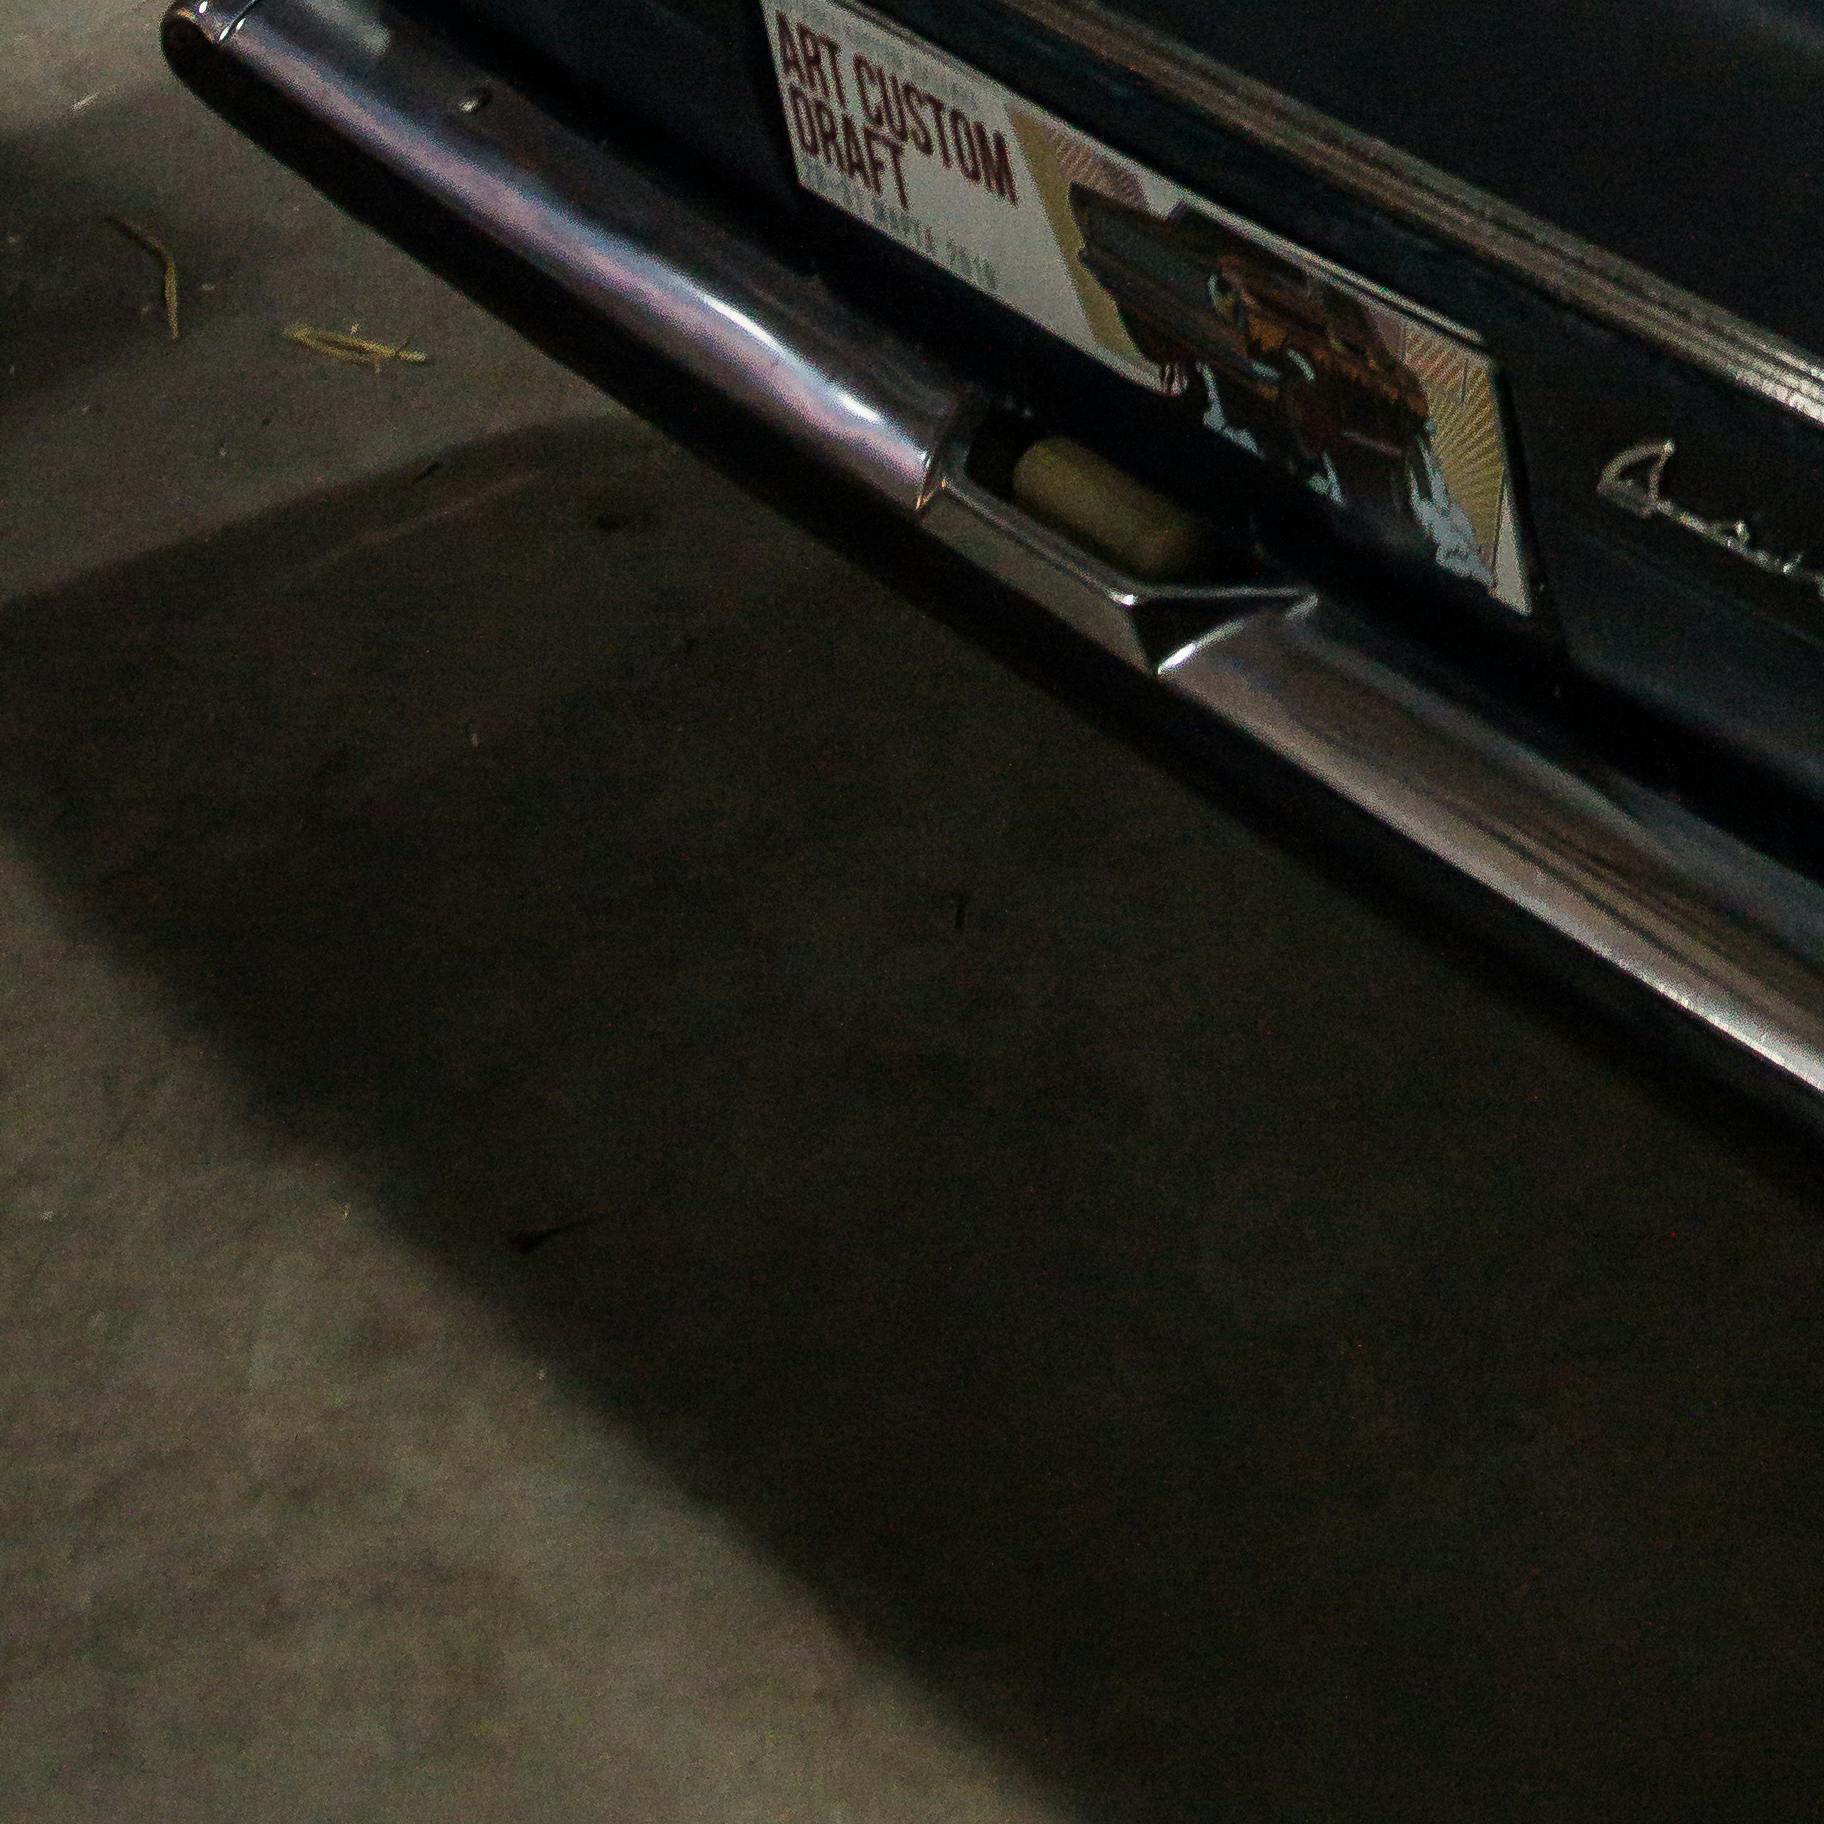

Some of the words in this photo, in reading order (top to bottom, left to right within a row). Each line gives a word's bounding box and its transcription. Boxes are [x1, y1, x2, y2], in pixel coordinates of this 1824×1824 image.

[775, 8, 847, 109] ART
[852, 51, 1019, 208] CUSTOM
[788, 83, 911, 211] DRAFT
